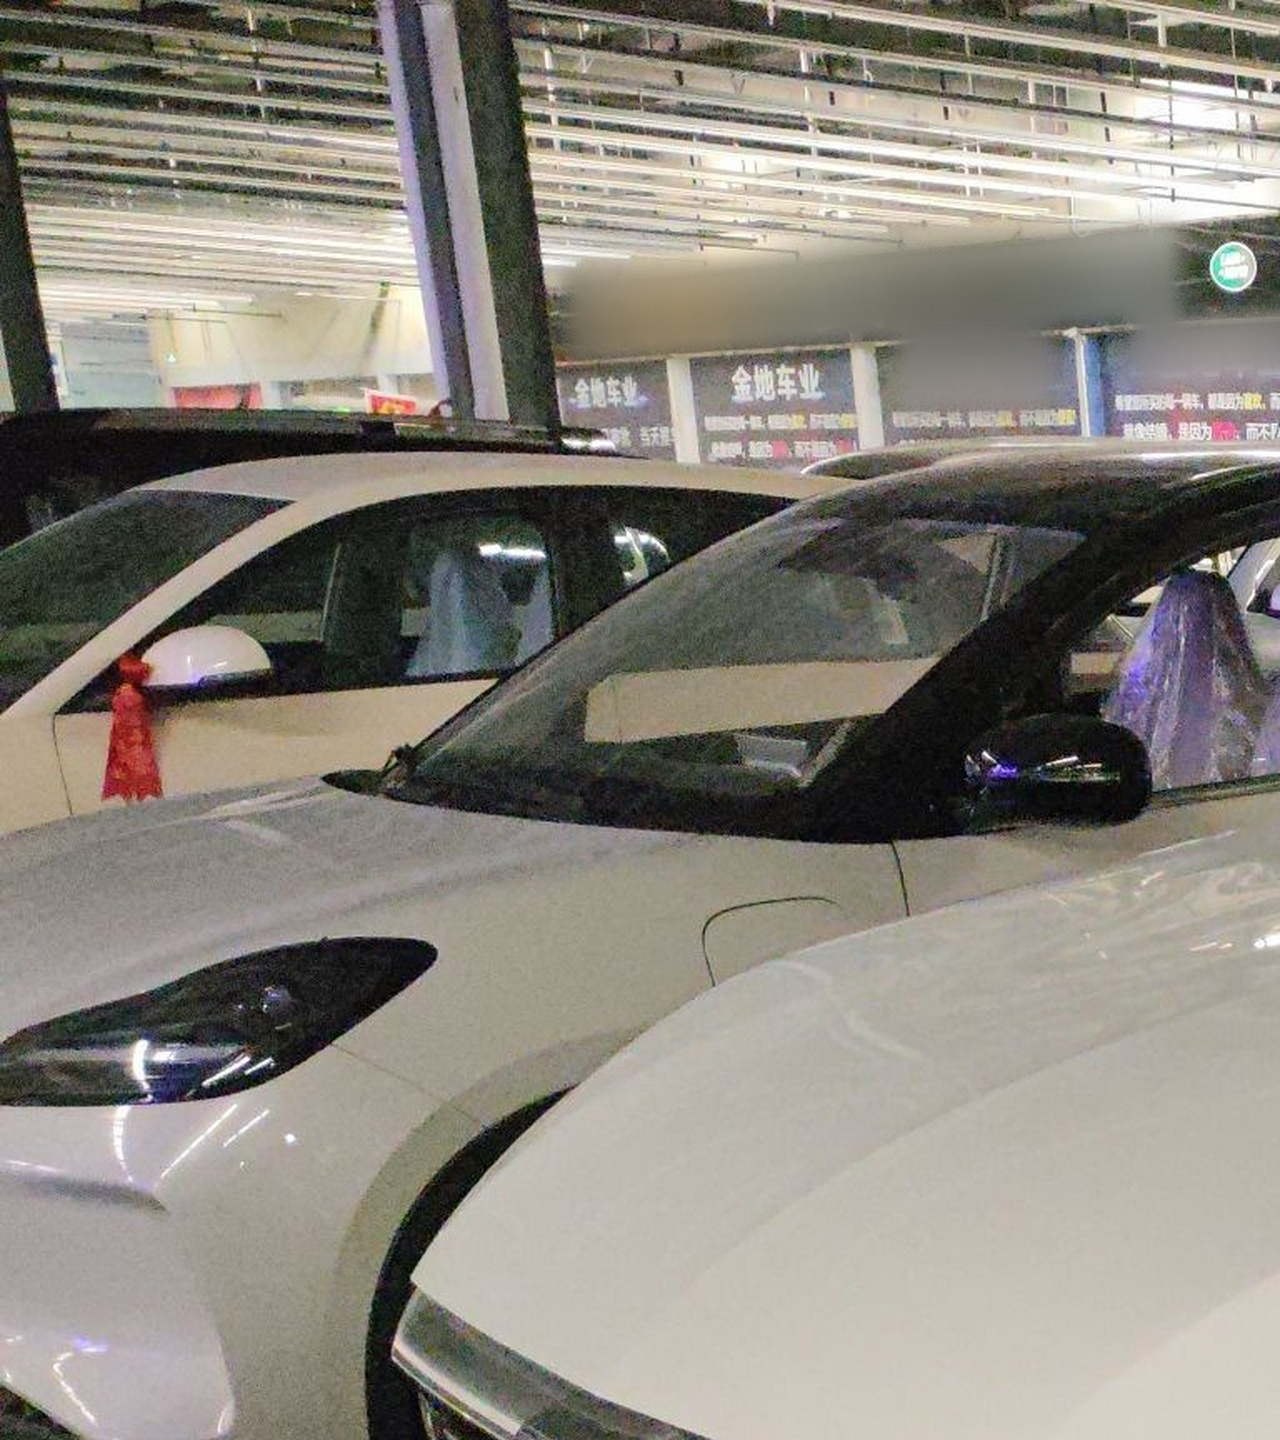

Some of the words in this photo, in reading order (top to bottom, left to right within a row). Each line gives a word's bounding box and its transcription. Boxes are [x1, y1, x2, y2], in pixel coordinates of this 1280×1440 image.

[574, 374, 639, 409] 金地车业
[731, 363, 825, 402] 金地车业
